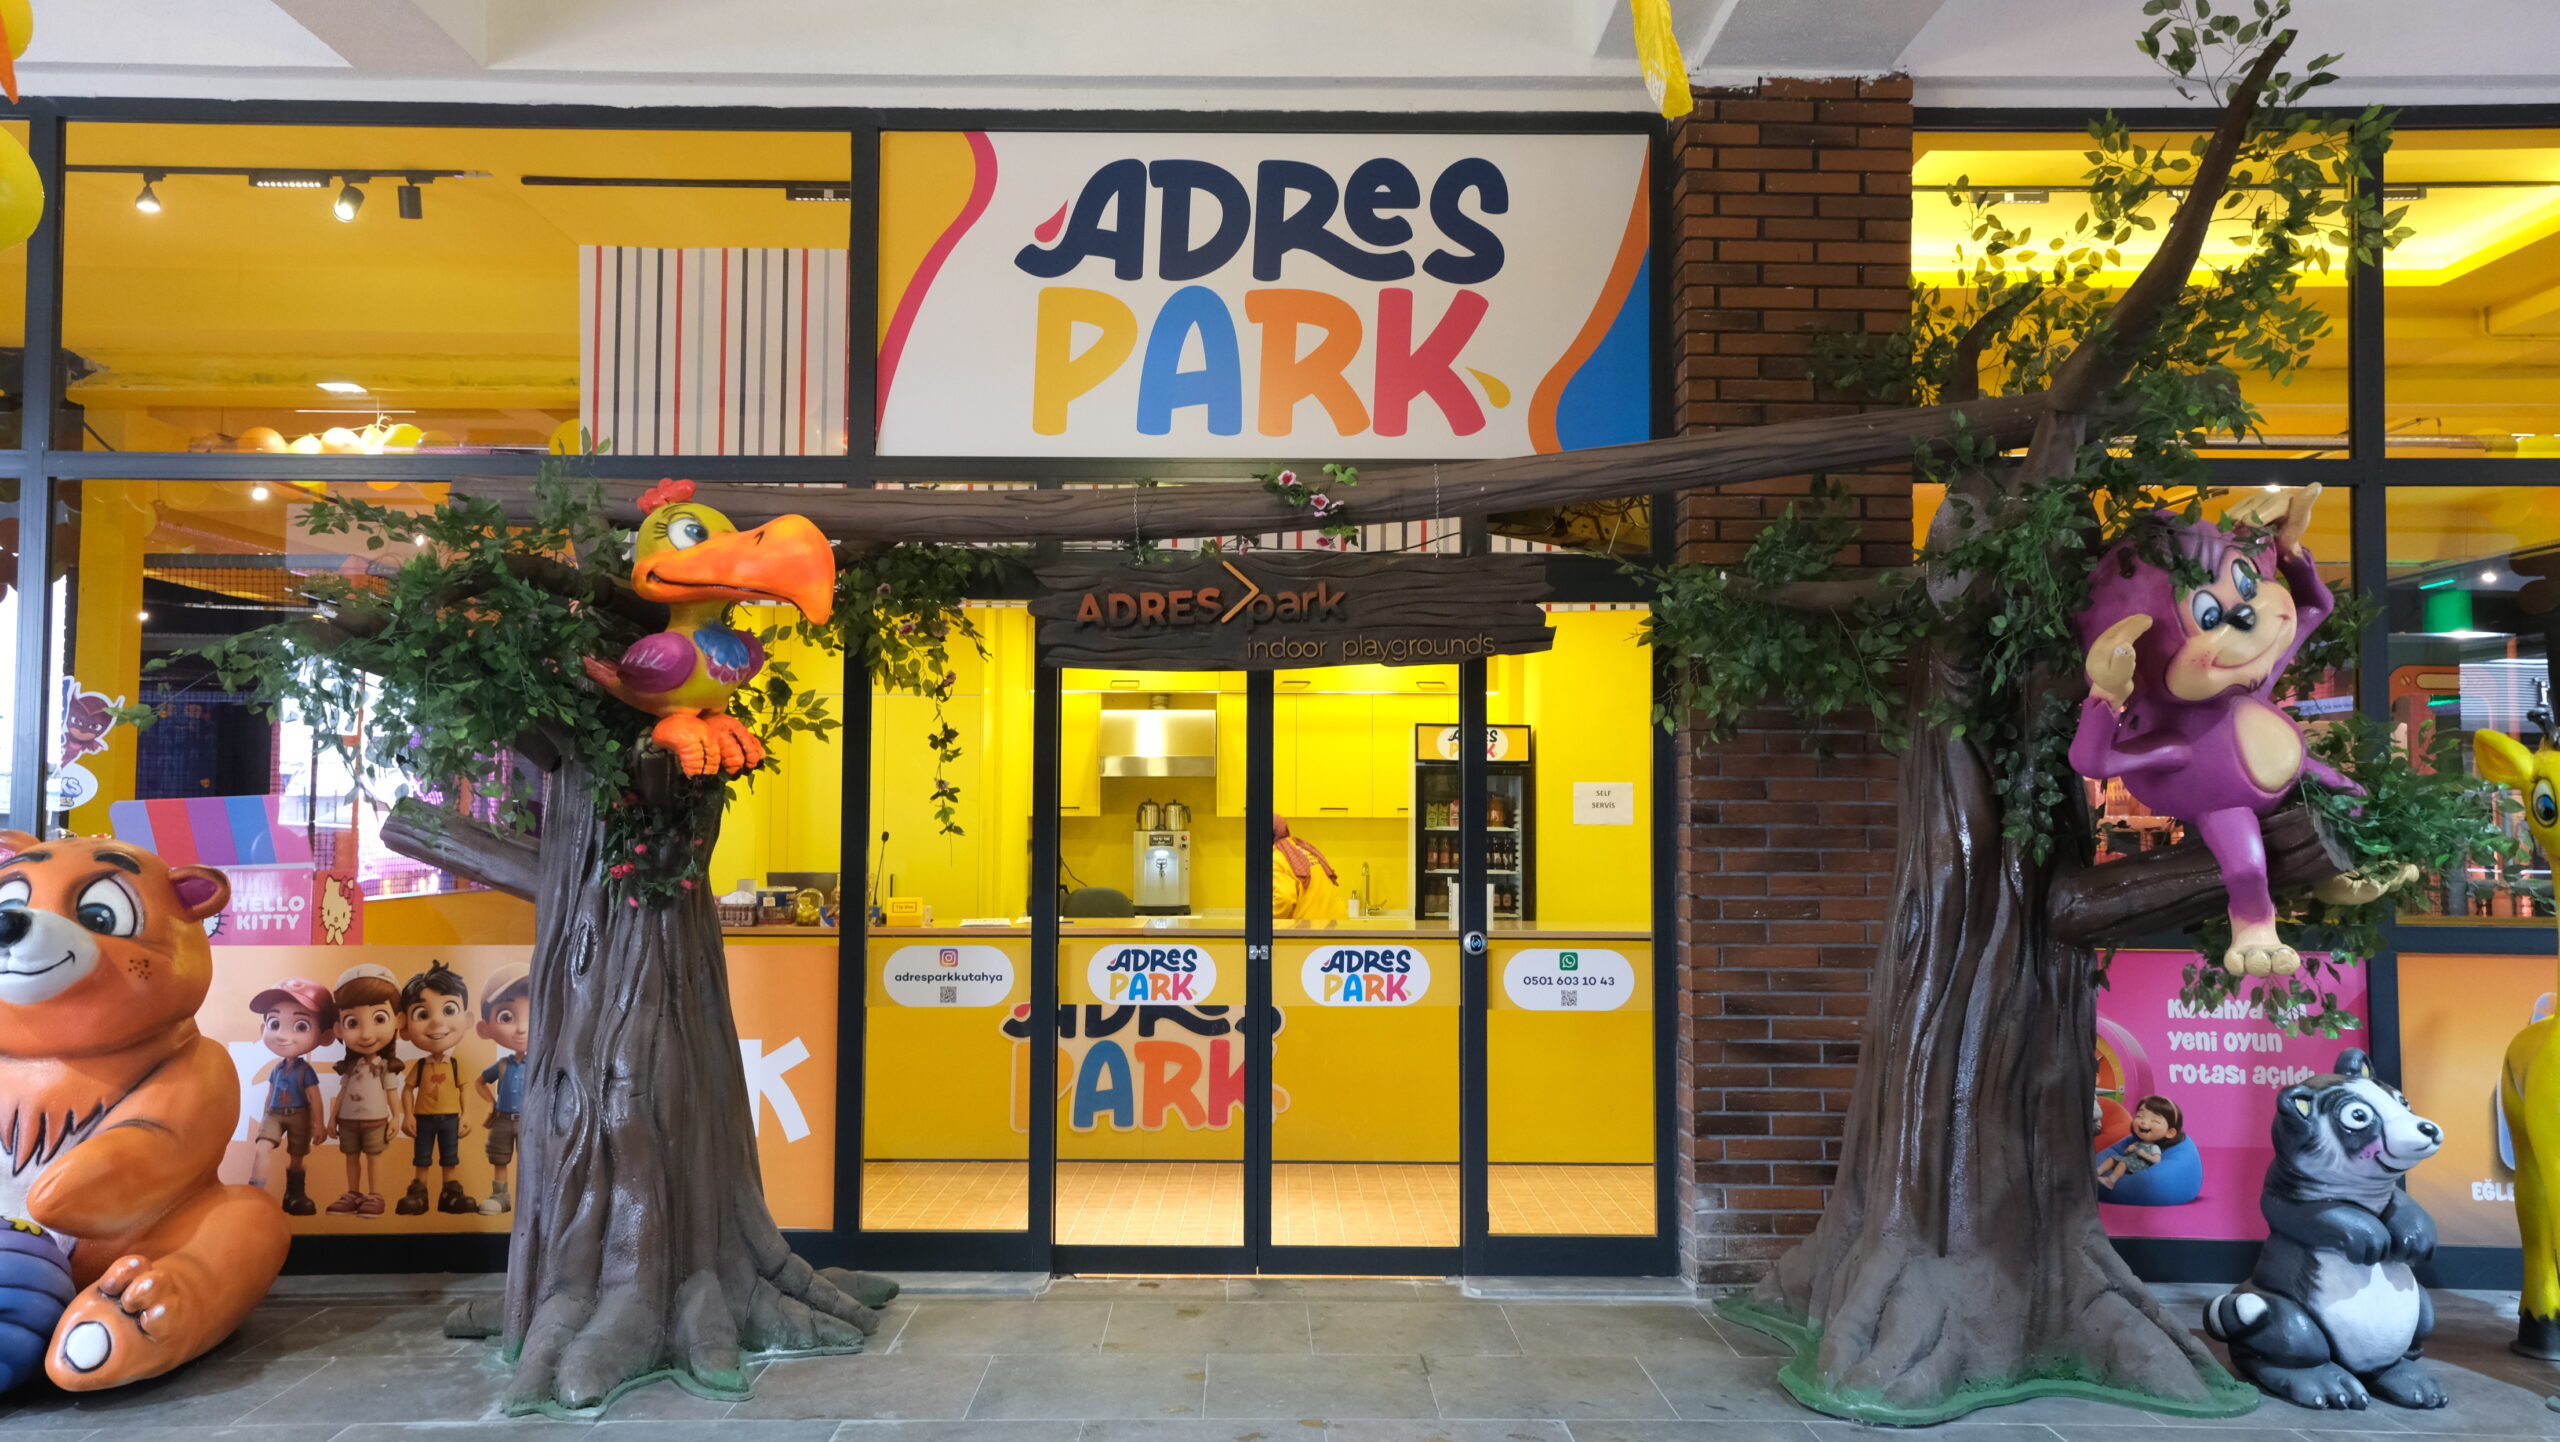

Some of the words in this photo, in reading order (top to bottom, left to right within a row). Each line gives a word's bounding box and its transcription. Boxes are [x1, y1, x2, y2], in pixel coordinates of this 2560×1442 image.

[1032, 285, 1489, 437] PARK
[1076, 587, 1224, 629] ADRES
[1247, 582, 1347, 630] park
[1247, 636, 1328, 660] indoor
[1343, 633, 1496, 662] playgrounds
[231, 896, 305, 912] HELLO
[236, 913, 300, 930] KITTY
[894, 972, 1003, 984] adresparkkutahya
[1109, 973, 1194, 1001] PARK
[1323, 974, 1408, 1002] PARK
[1523, 976, 1553, 986] 0501
[1556, 976, 1579, 986] 603
[1582, 976, 1597, 986] 10
[1600, 976, 1615, 986] 43
[2167, 1031, 2218, 1052] yeni
[2223, 1032, 2283, 1053] oyun
[2169, 1064, 2247, 1085] rotası
